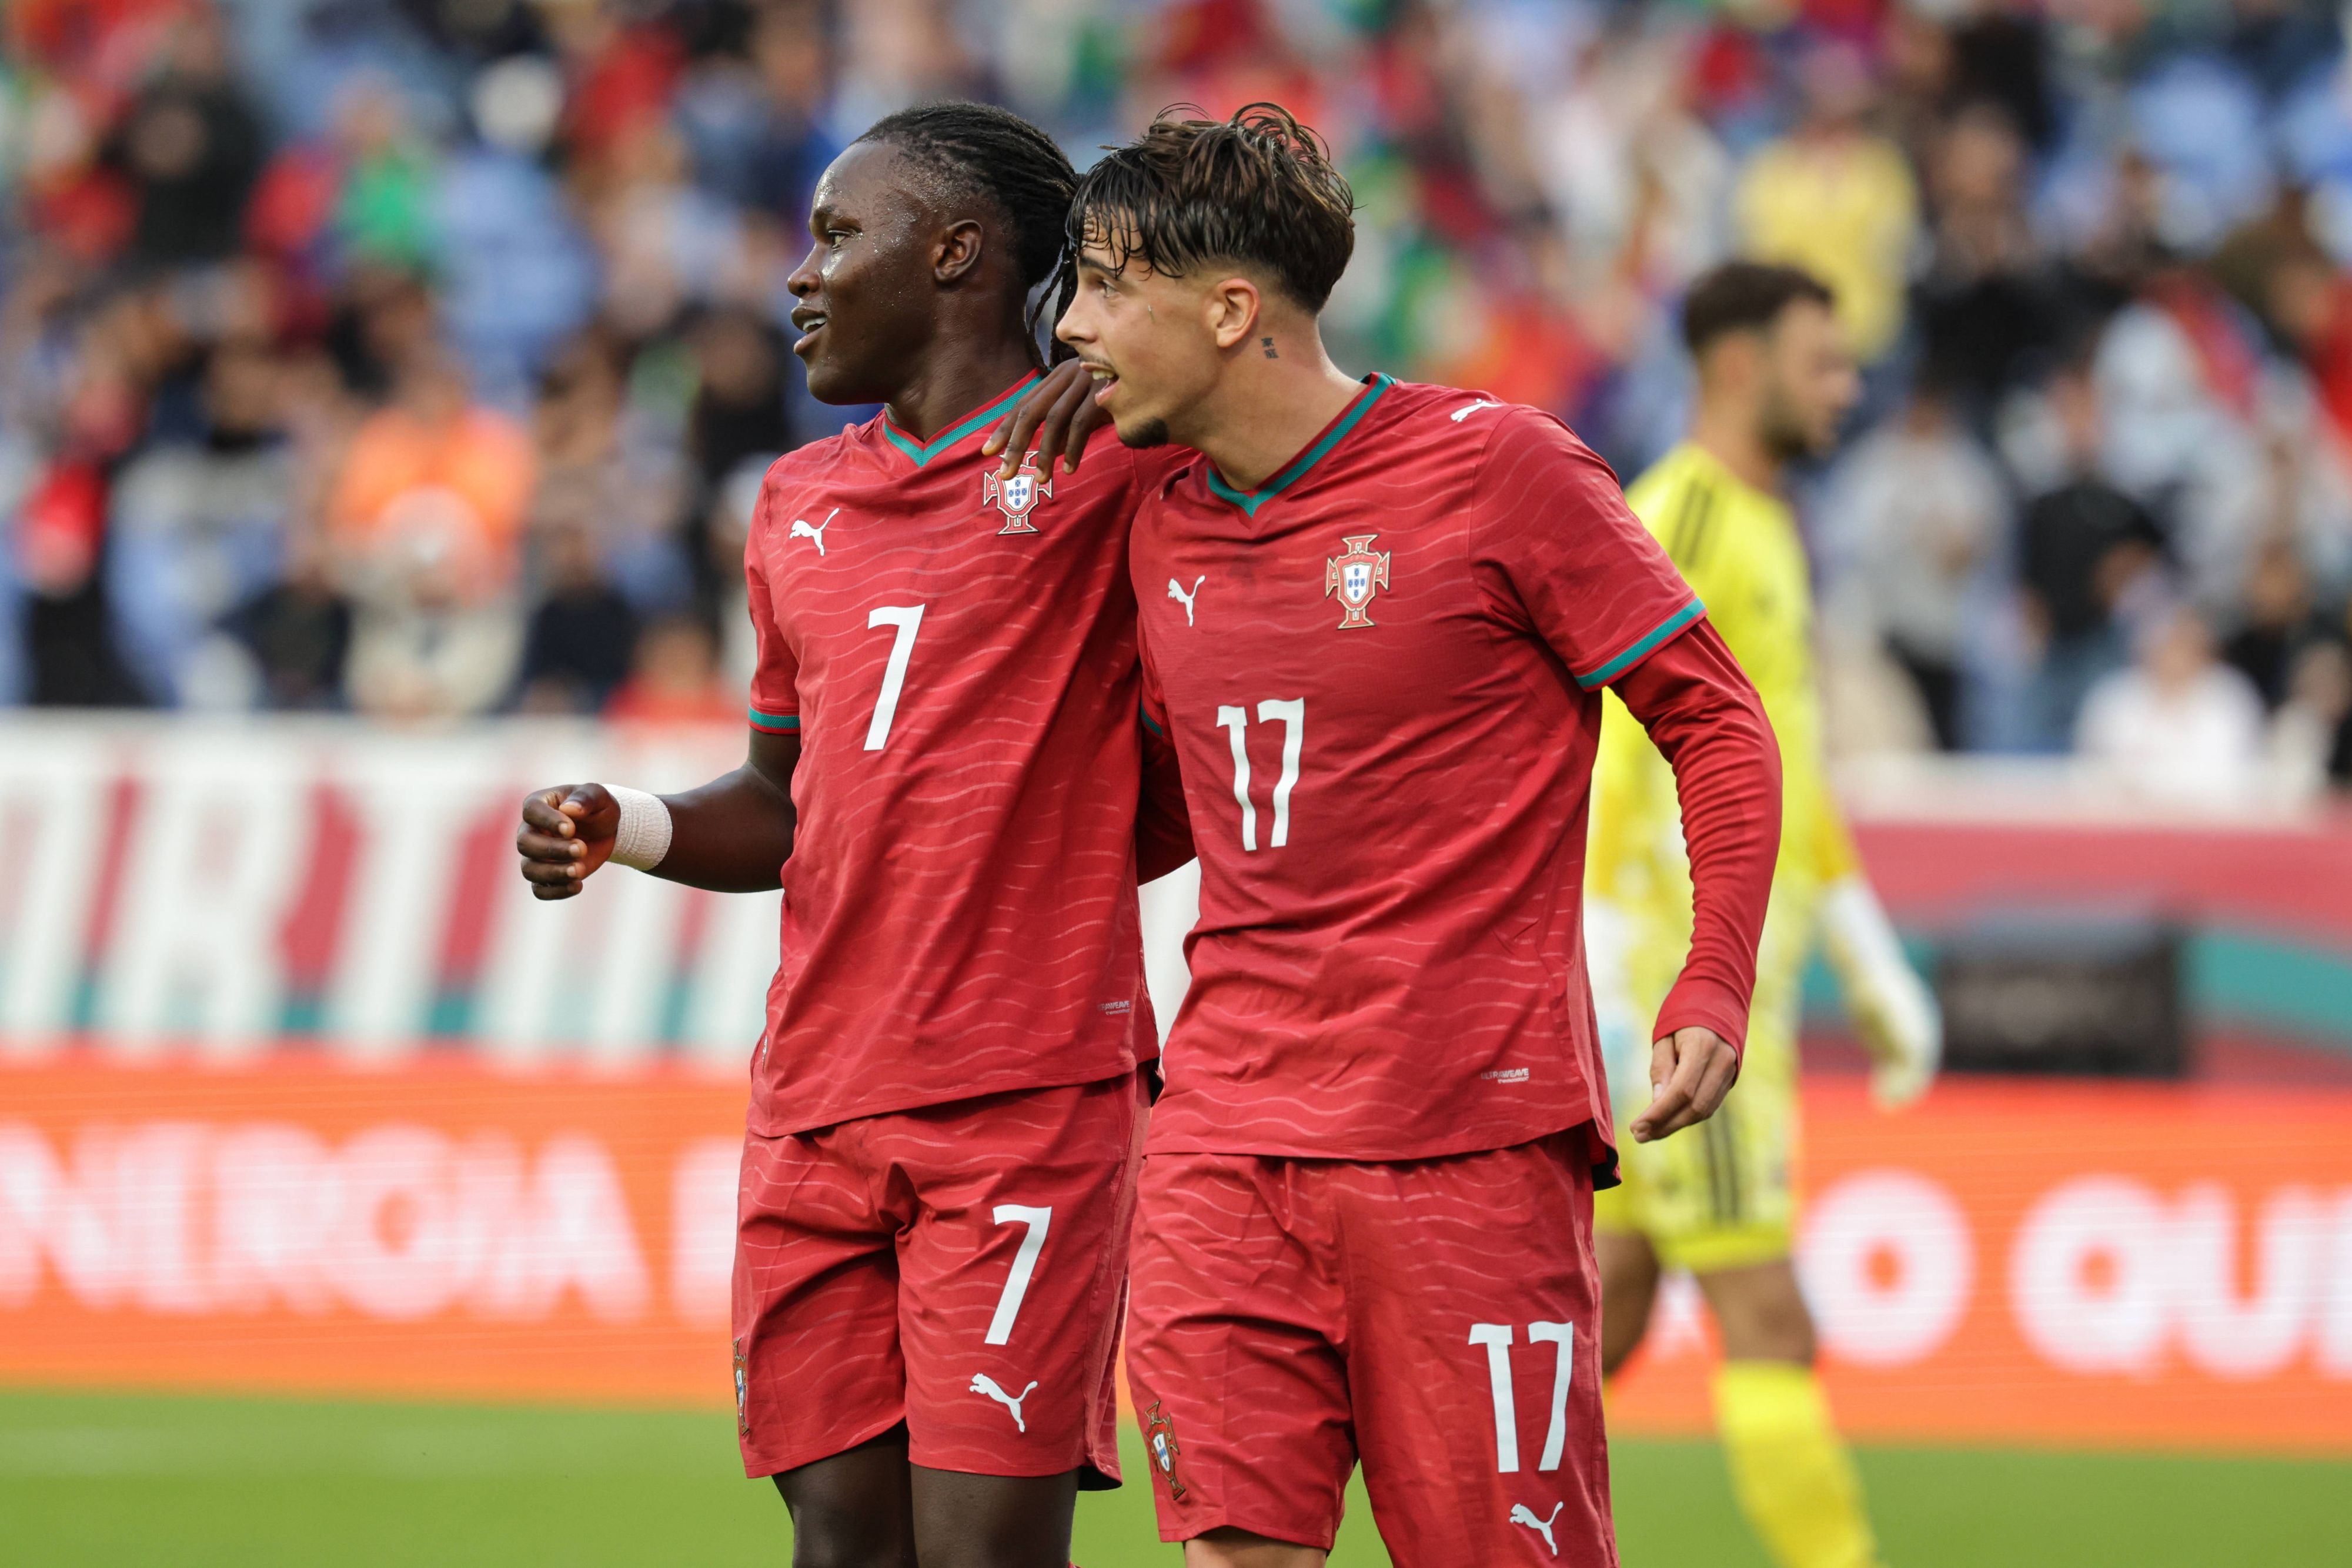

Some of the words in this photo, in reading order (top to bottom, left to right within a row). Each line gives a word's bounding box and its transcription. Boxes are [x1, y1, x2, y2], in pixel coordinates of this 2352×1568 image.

[863, 603, 926, 751] 7
[1217, 697, 1305, 851] 17
[984, 1204, 1053, 1345] 7
[1468, 1320, 1573, 1473] 17
